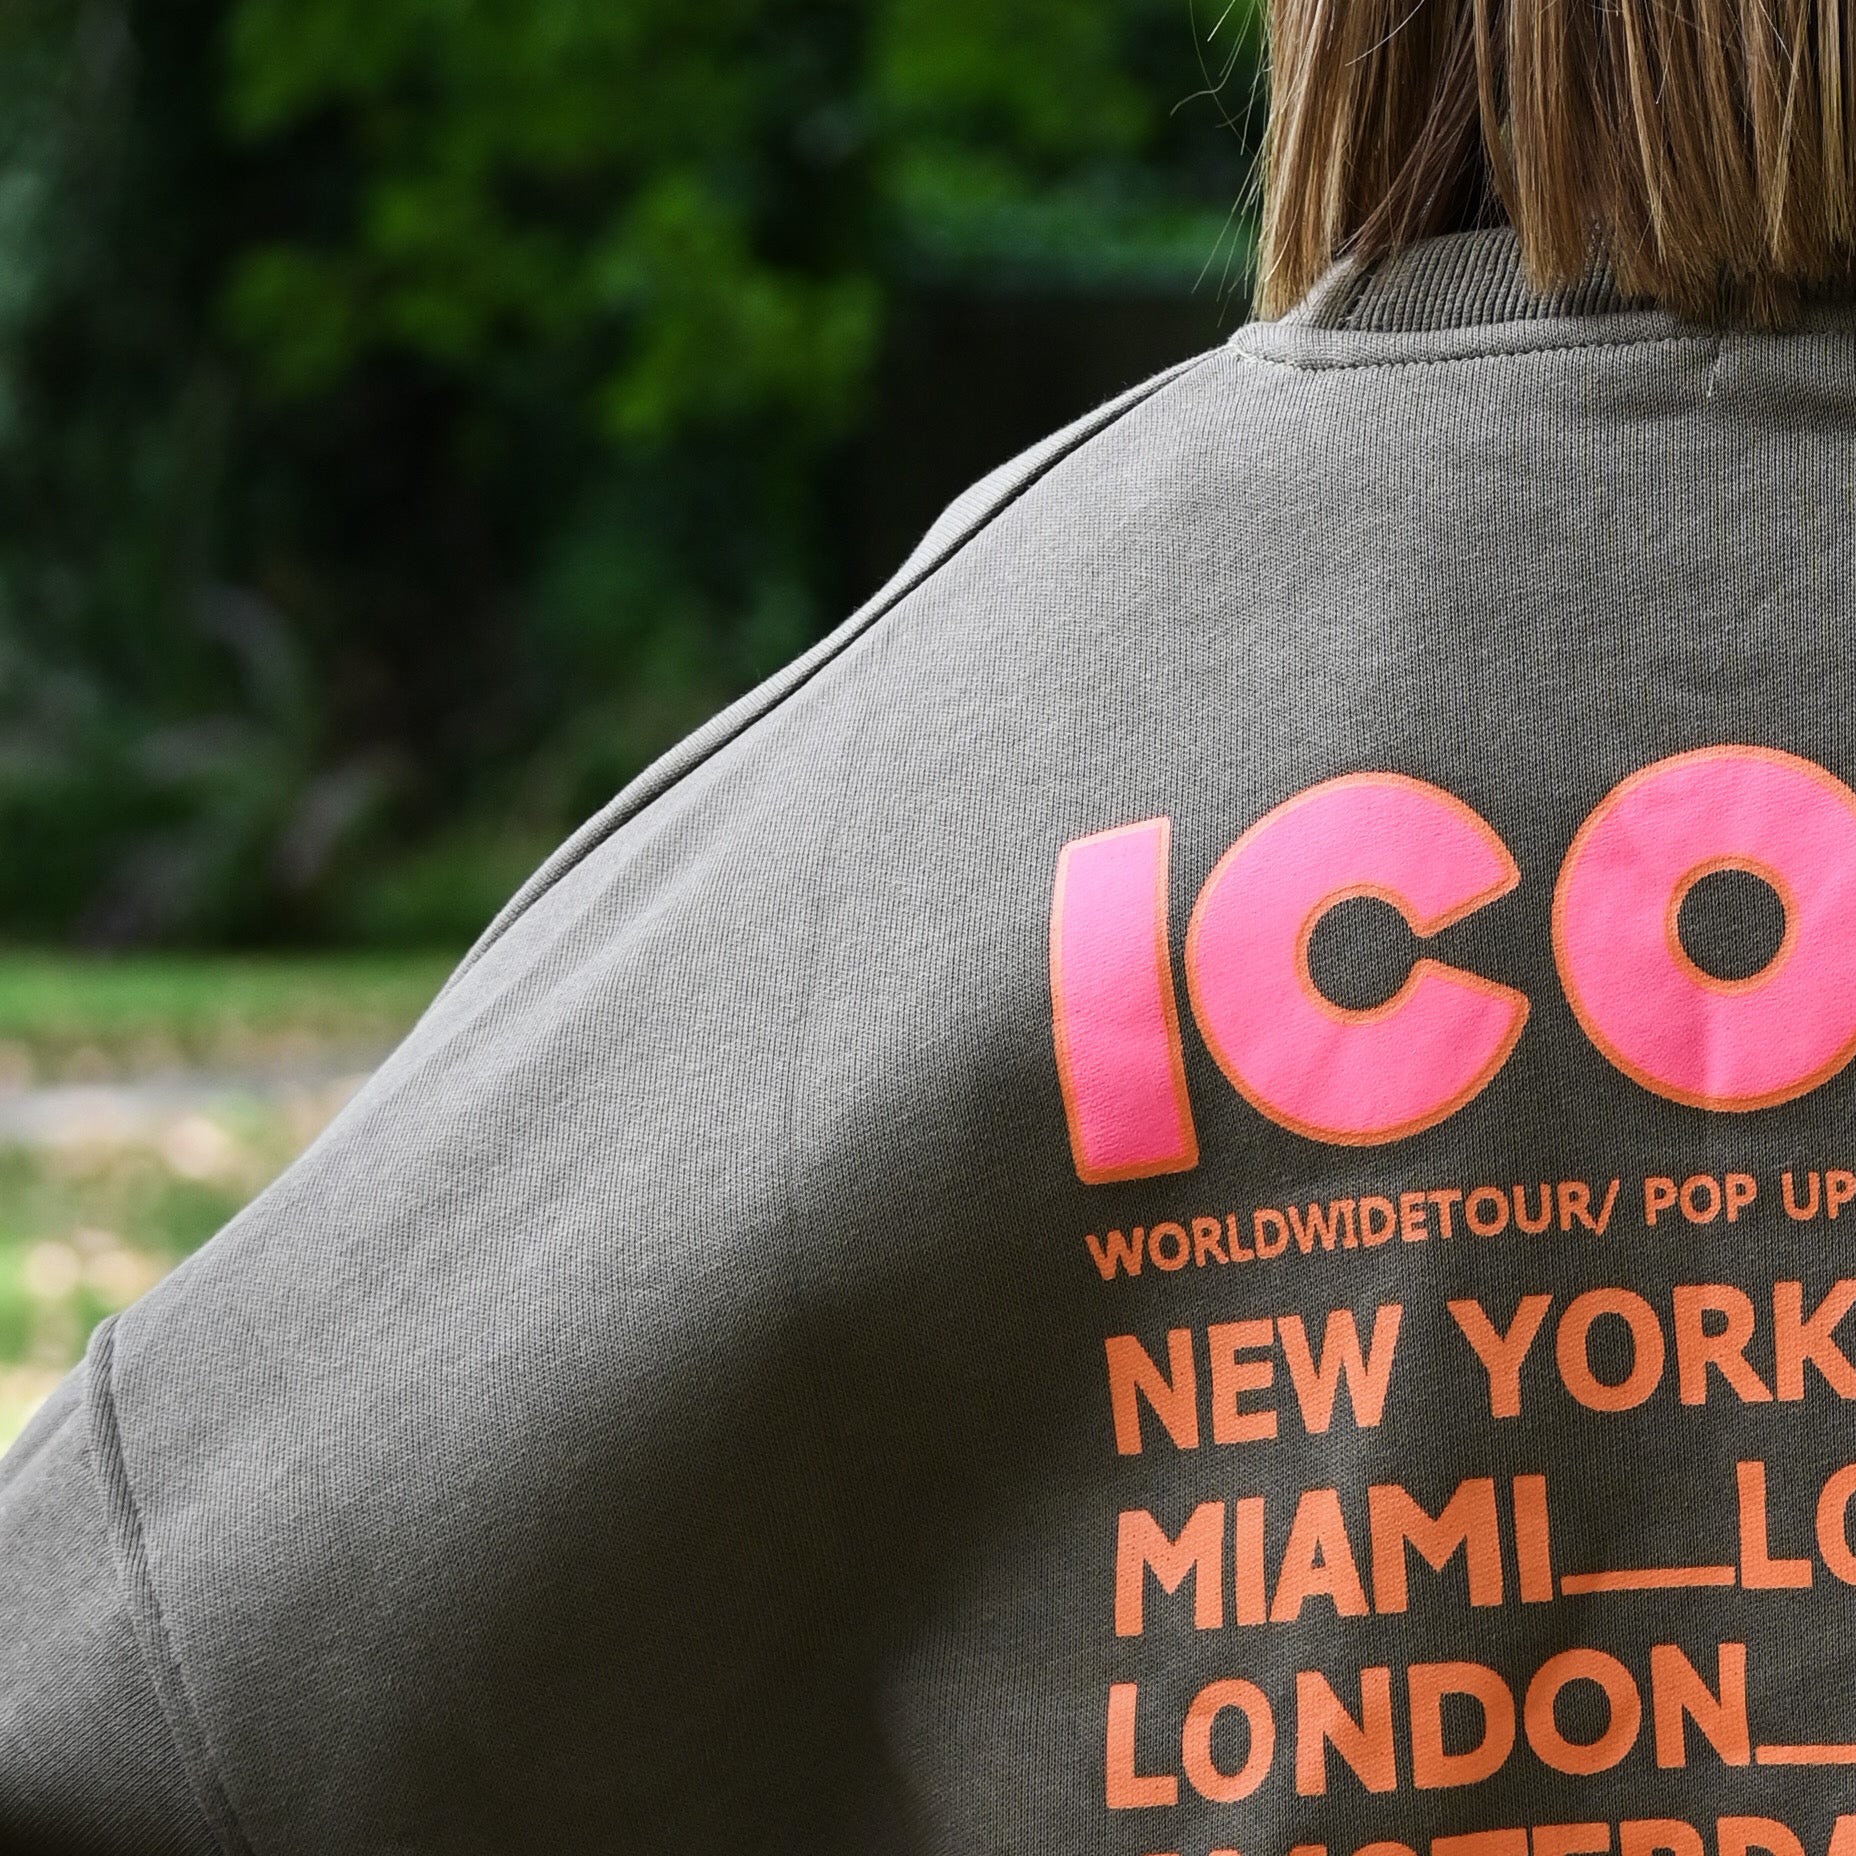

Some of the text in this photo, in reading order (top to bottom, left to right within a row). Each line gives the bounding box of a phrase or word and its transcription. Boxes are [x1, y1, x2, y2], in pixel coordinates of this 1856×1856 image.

[1645, 1173, 1759, 1228] POP
[1105, 1302, 1405, 1457] NEW
[1114, 1474, 1555, 1640] MIAMI
[1104, 1642, 1753, 1811] LONDON
